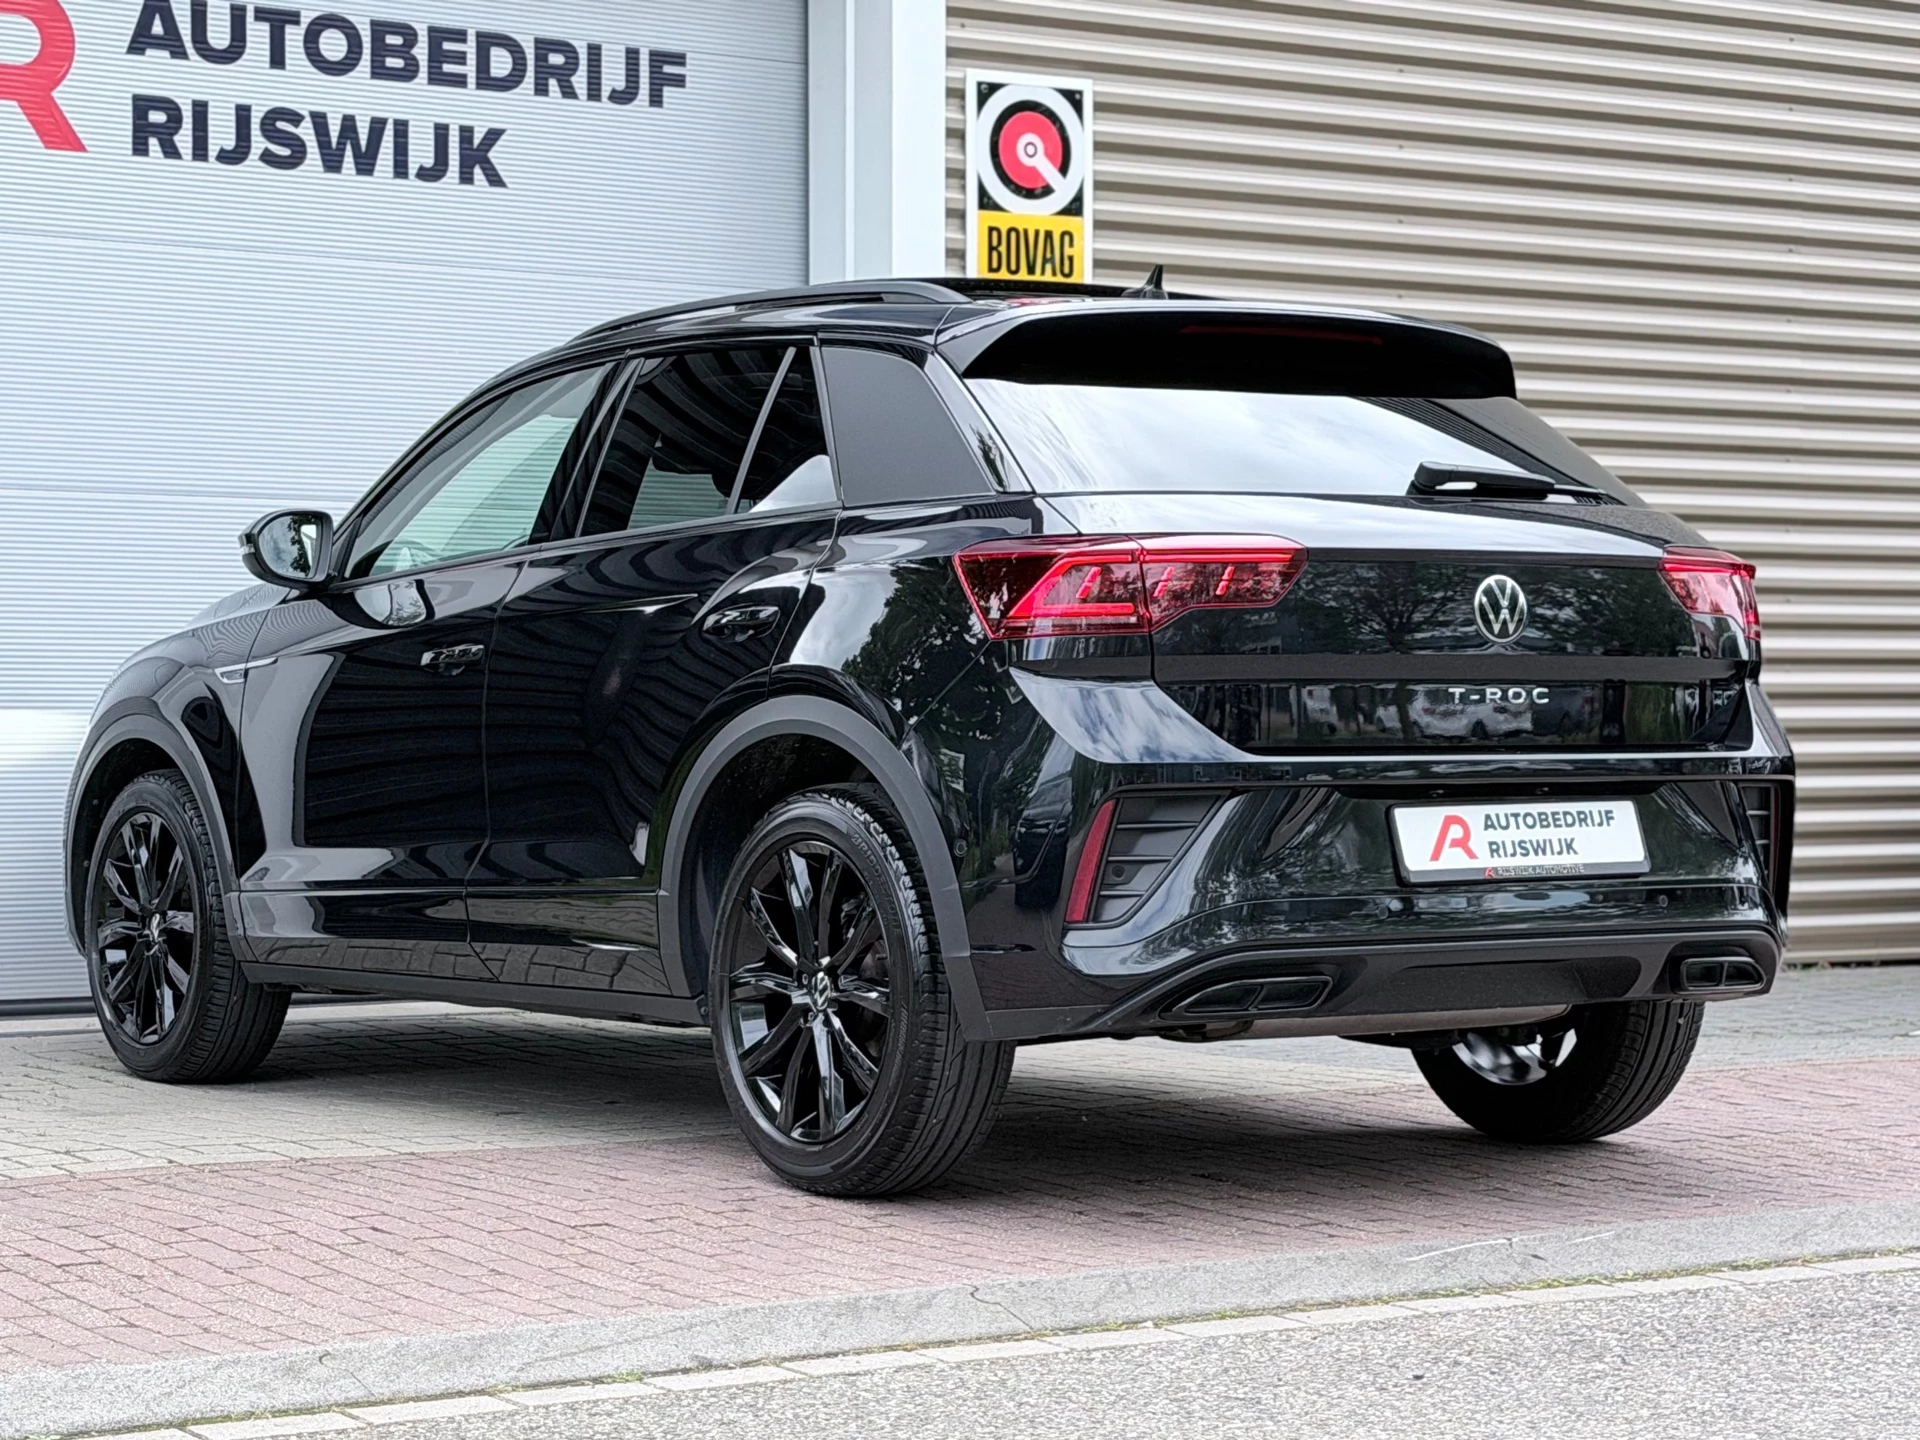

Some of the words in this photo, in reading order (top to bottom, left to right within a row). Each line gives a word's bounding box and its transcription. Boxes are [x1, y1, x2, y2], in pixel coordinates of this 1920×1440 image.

[126, 0, 688, 108] AUTOBEDRIJF
[131, 93, 508, 188] RIJSWIJK
[987, 225, 1075, 279] BOVAG
[1448, 687, 1550, 704] T-ROC
[1483, 809, 1616, 832] AUTOBEDRIJF
[1487, 837, 1579, 859] RIJSWIJK
